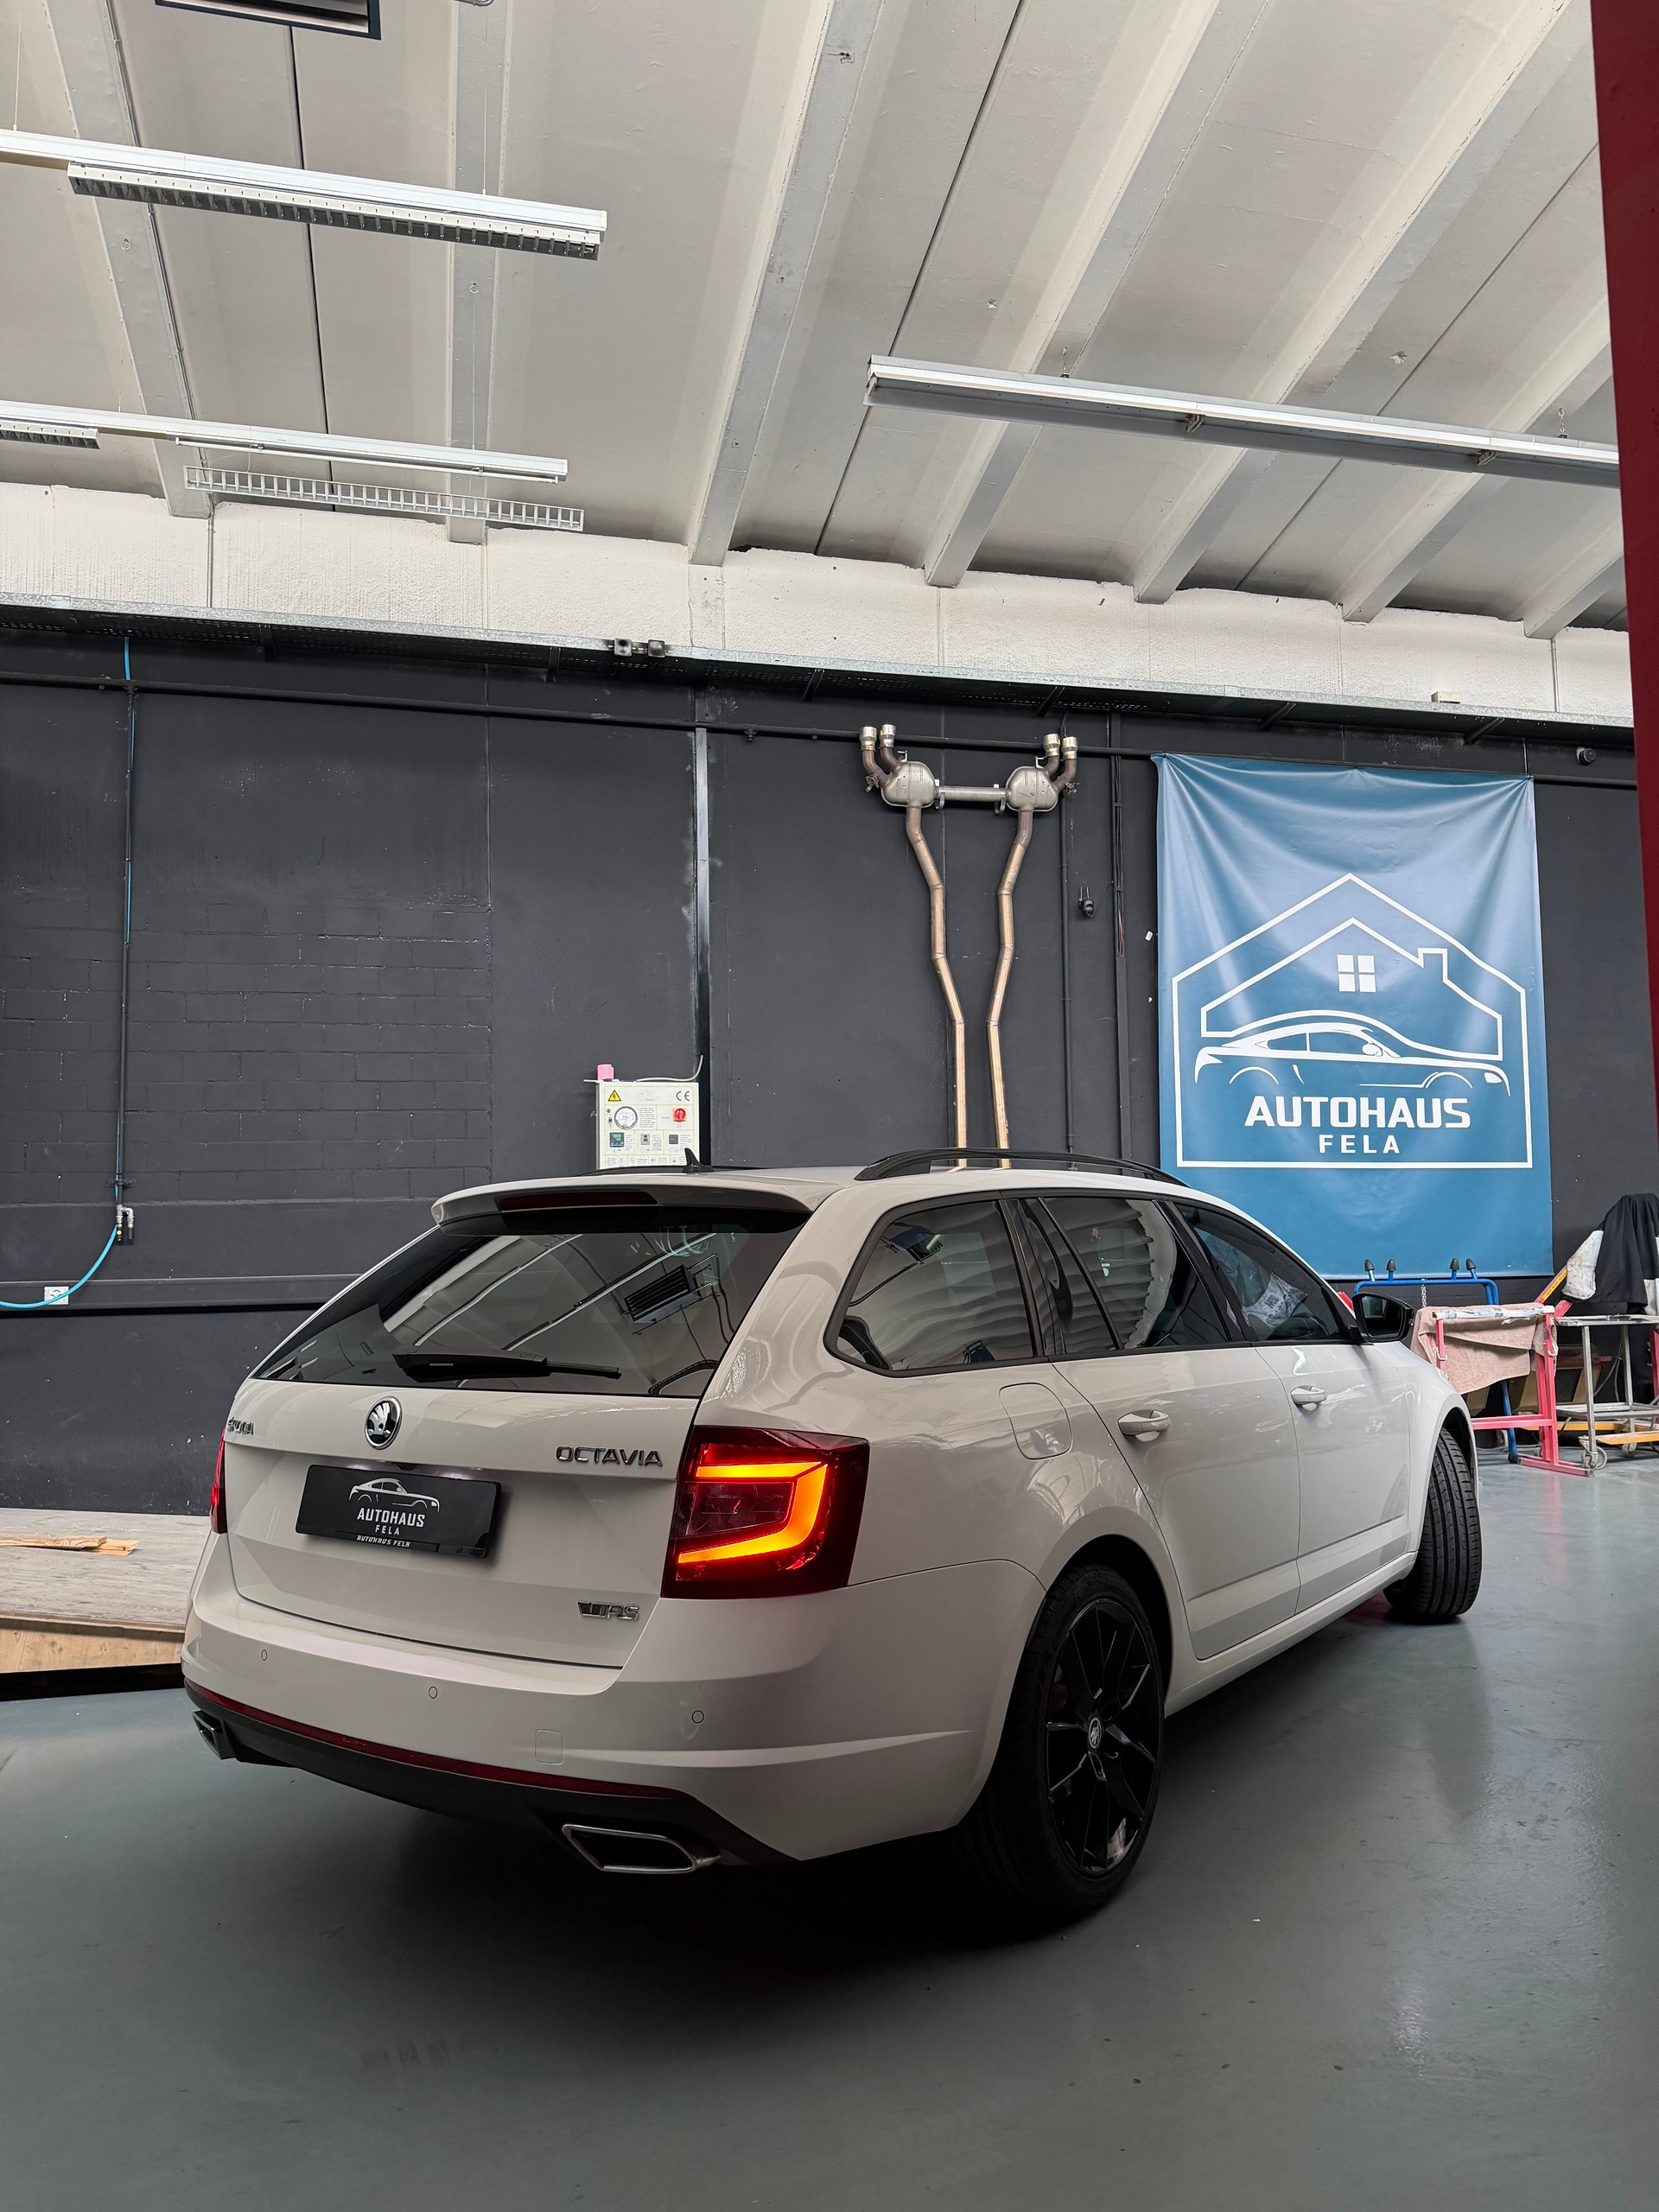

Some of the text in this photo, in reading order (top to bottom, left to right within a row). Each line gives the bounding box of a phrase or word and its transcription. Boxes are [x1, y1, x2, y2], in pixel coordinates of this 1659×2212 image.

[676, 1090, 690, 1102] CE
[1243, 1095, 1471, 1128] AUTOHAUS
[1319, 1134, 1401, 1154] FELA
[556, 1445, 663, 1467] OCTAVIA
[357, 1507, 425, 1527] AUTOHAUS
[375, 1524, 400, 1535] FELA
[356, 1535, 410, 1548] AUTOHAUS FELA
